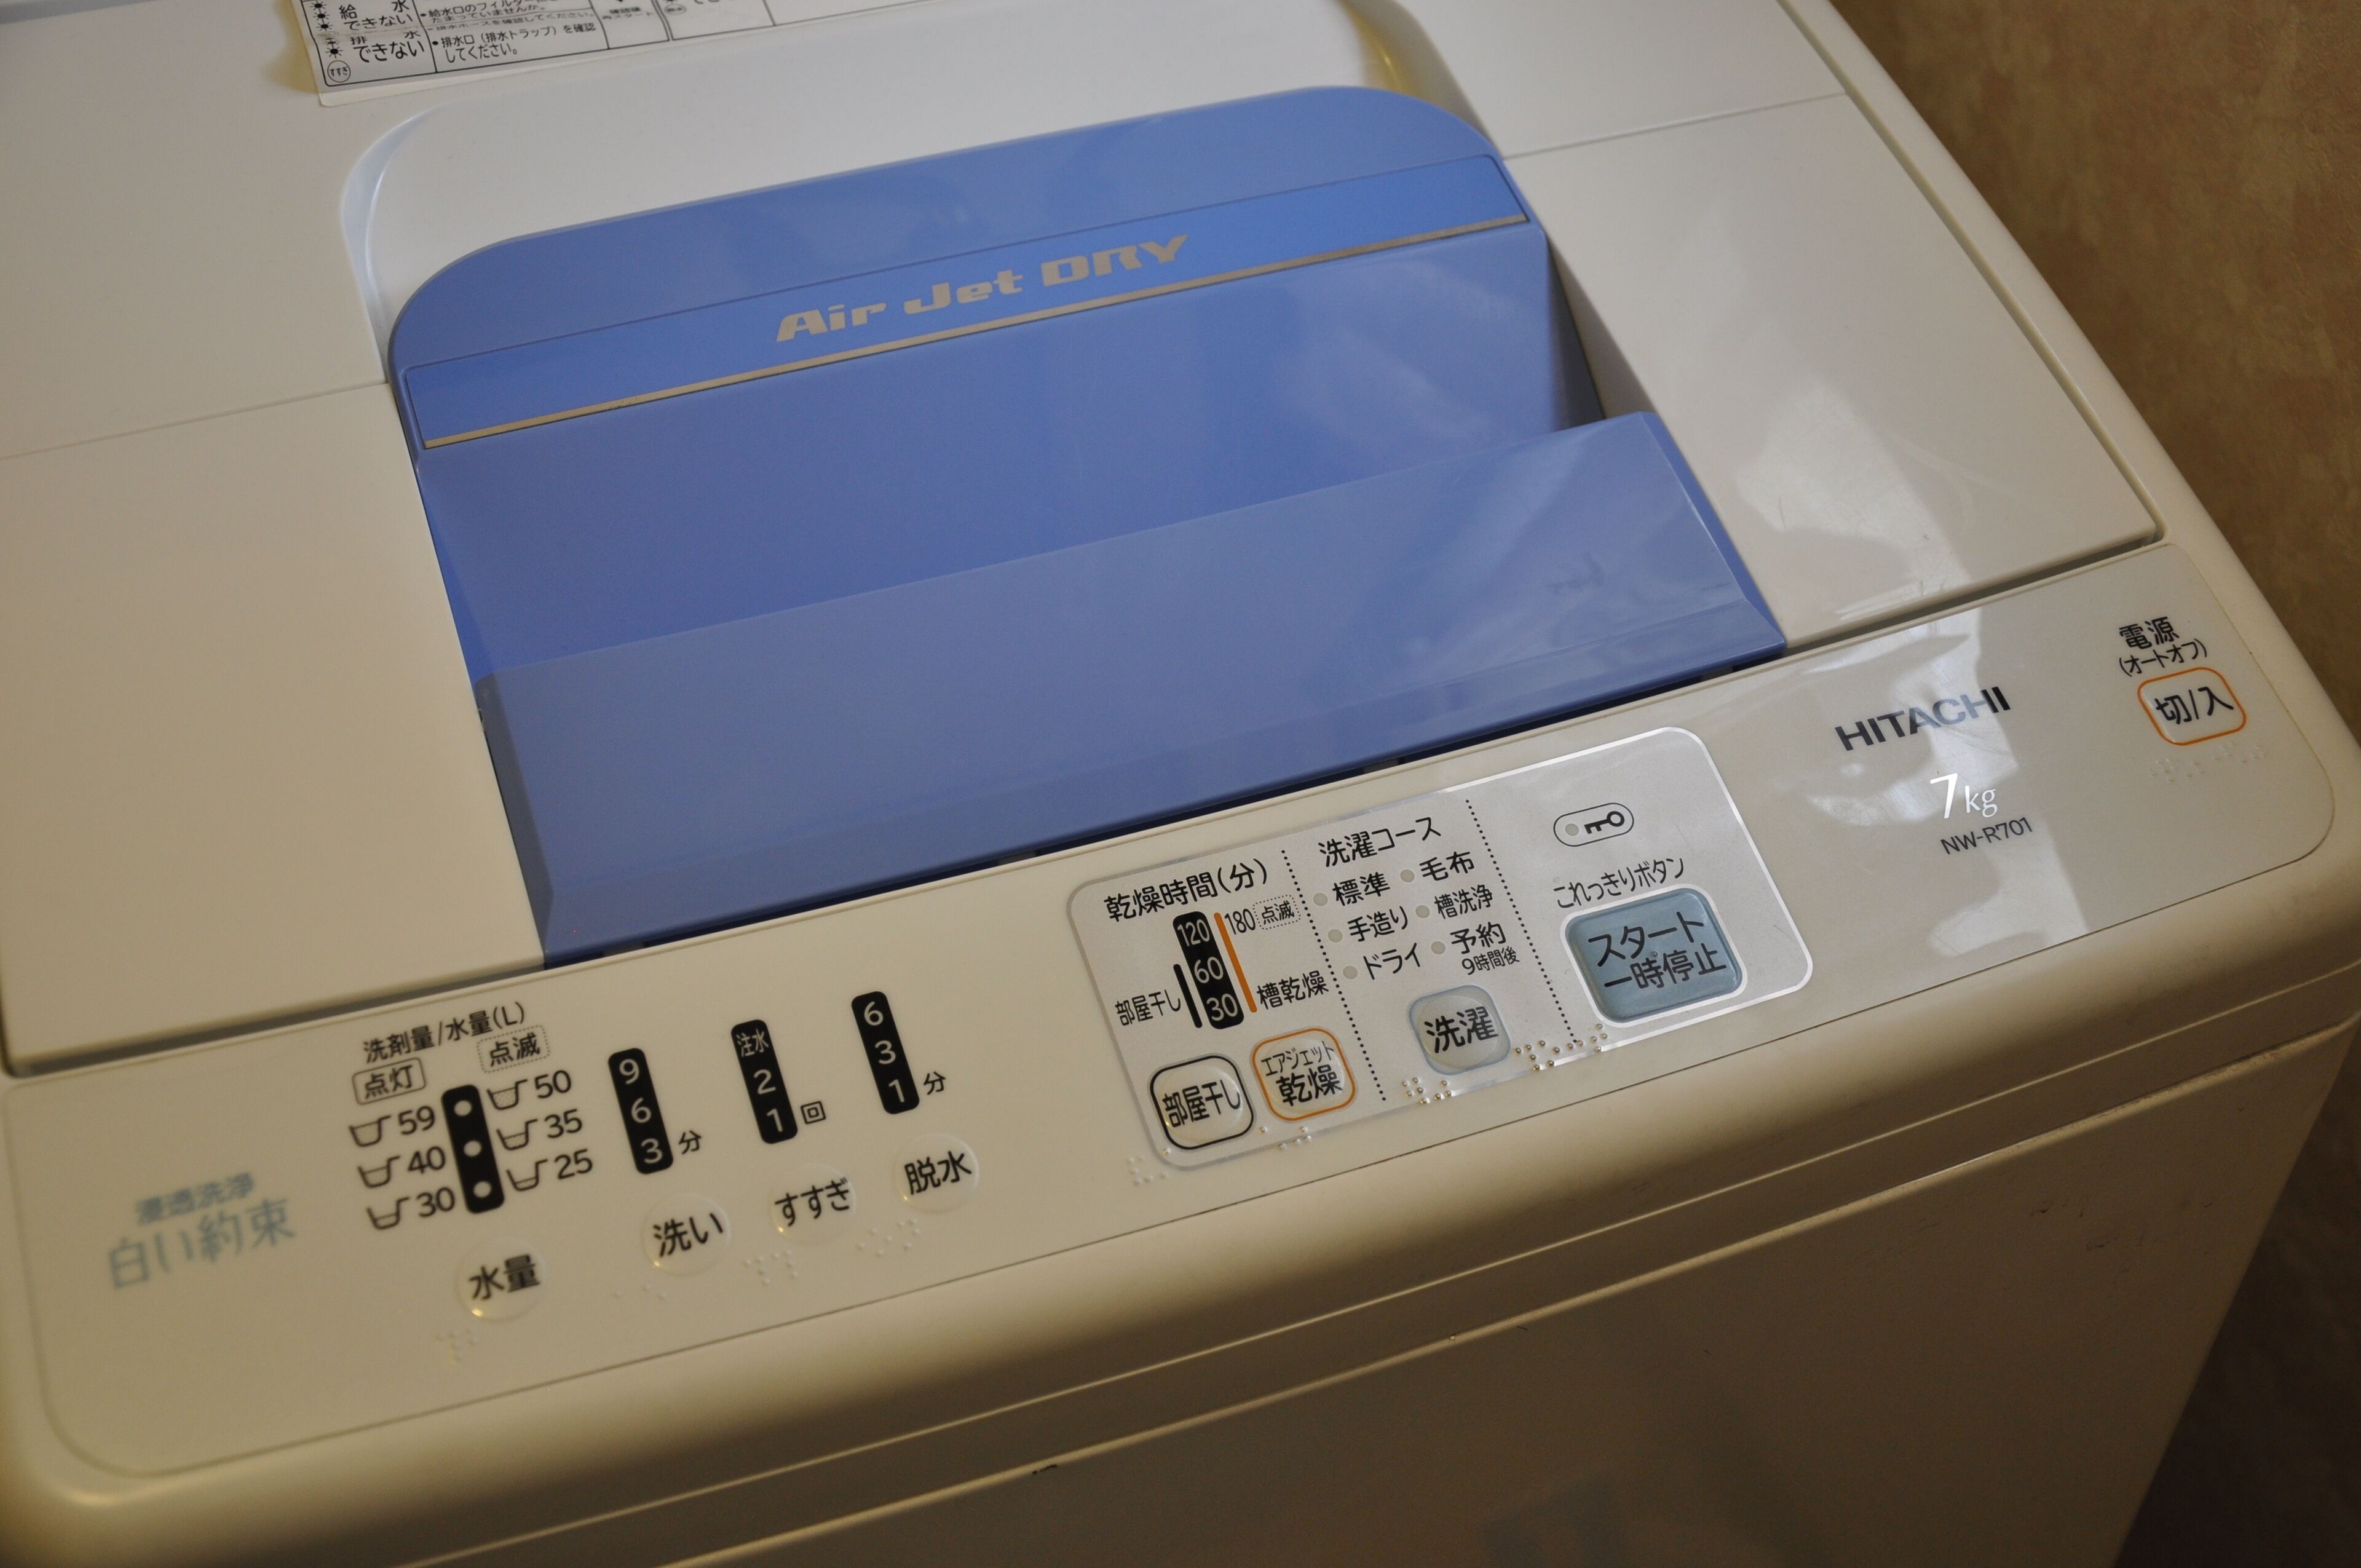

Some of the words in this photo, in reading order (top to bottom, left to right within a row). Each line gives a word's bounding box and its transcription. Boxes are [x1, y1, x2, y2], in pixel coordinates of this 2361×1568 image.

[344, 14, 413, 30] できない
[354, 41, 425, 63] できない
[445, 43, 517, 63] してください。
[330, 66, 348, 77] すすぎ
[777, 304, 886, 342] Air
[904, 269, 1023, 314] Jet
[1040, 234, 1189, 287] DRY
[2119, 616, 2181, 651] 電源
[2118, 639, 2209, 677] (オートオフ)
[1835, 686, 2012, 751] HITACHI
[2154, 686, 2234, 726] 切/入
[1318, 817, 1441, 868] 洗濯コース
[1940, 817, 2033, 855] NW-R701
[1104, 858, 1267, 922] 乾燥時間(分)
[1332, 872, 1390, 906] 標準
[1419, 851, 1475, 882] 毛布
[1553, 857, 1684, 908] これっきりボタン
[1224, 908, 1256, 935] 180
[1261, 900, 1295, 925] 点滅
[1348, 906, 1409, 942] 手造り
[1434, 884, 1493, 919] 槽洗浄
[1177, 919, 1211, 947] 120
[1588, 911, 1704, 967] スタート
[1363, 943, 1421, 980] ドライ
[1450, 922, 1506, 954] 予約
[1461, 946, 1520, 975] 9時間後
[1604, 943, 1727, 989] 一時停止
[1193, 956, 1224, 984] 60
[1115, 989, 1181, 1026] 部屋干し
[1206, 993, 1238, 1022] 30
[1256, 970, 1329, 1010] 槽乾燥
[864, 1001, 884, 1026] 6
[1424, 1006, 1498, 1054] 洗濯
[489, 1032, 540, 1067] 点滅
[737, 1029, 770, 1058] 注水
[874, 1040, 896, 1064] 3
[1260, 1041, 1334, 1077] エアジェット
[364, 1065, 412, 1099] 点灯
[534, 1070, 571, 1098] 50
[619, 1058, 639, 1085] 9
[753, 1069, 777, 1095] 2
[888, 1079, 905, 1103] 1
[923, 1071, 946, 1095] 分
[1275, 1064, 1344, 1107] 乾燥
[398, 1106, 435, 1135] 59
[631, 1098, 651, 1124] 6
[766, 1109, 783, 1133] 1
[801, 1101, 826, 1125] 回
[1162, 1080, 1241, 1128] 部屋干し
[544, 1109, 582, 1138] 35
[408, 1146, 446, 1174] 40
[555, 1149, 593, 1179] 25
[641, 1138, 663, 1165] 3
[678, 1130, 702, 1155] 分
[904, 1150, 972, 1195] 脱水
[416, 1187, 455, 1218] 30
[775, 1178, 850, 1227] すすぎ
[108, 1198, 296, 1290] 白い約束
[653, 1213, 723, 1257] 洗い
[469, 1254, 540, 1301] 水量
